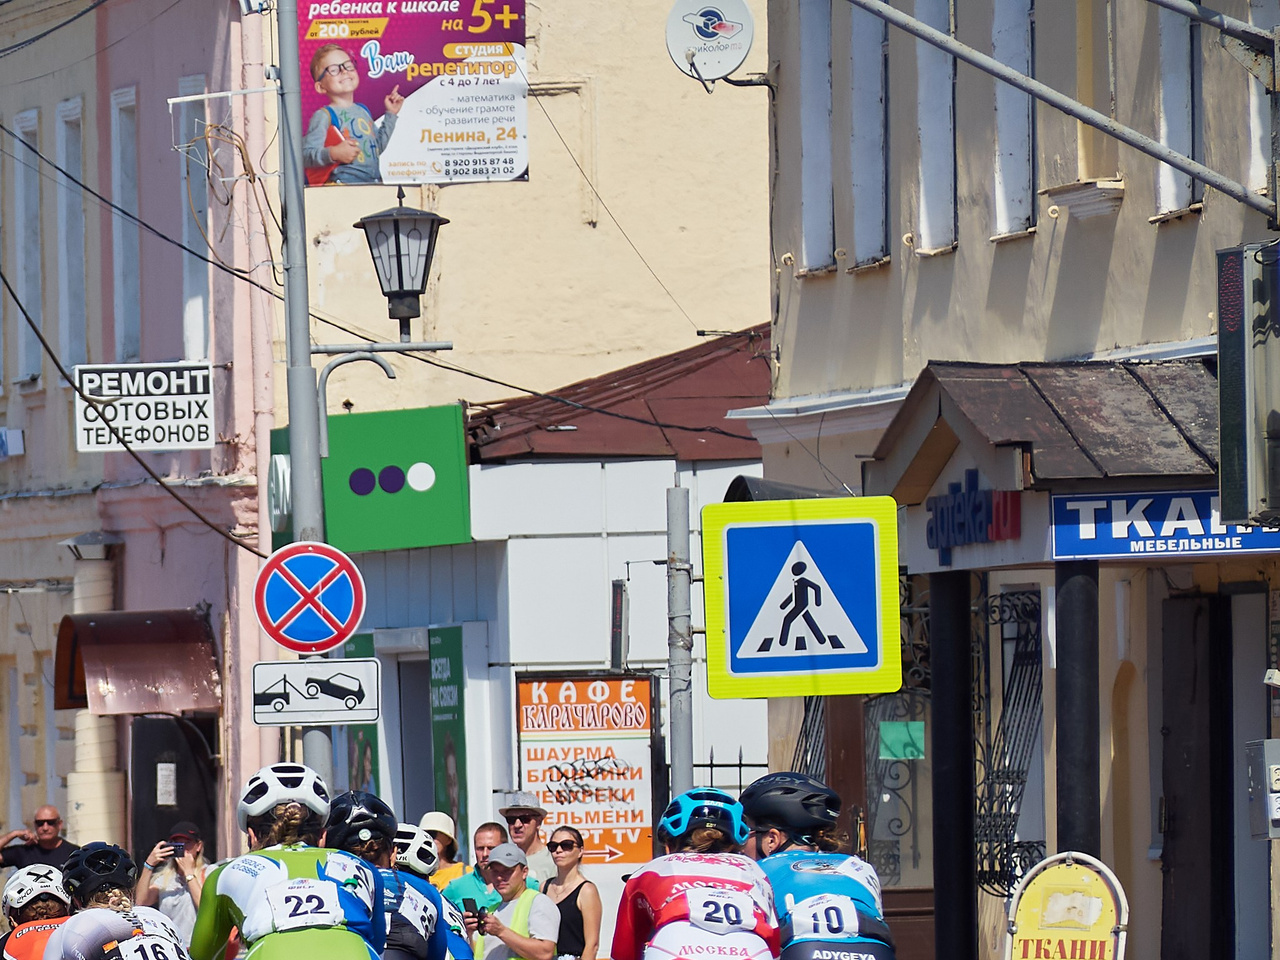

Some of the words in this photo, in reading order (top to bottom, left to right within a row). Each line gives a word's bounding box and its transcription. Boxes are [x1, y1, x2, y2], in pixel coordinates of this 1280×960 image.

[308, 0, 383, 19] ребенка
[386, 1, 398, 14] к
[401, 0, 460, 13] школе
[441, 16, 463, 31] на
[468, 0, 518, 33] 5+
[319, 24, 350, 37] 200
[350, 28, 380, 36] рублей
[361, 40, 414, 78] Ваш
[455, 43, 504, 56] студия
[407, 60, 517, 81] репетитор
[448, 77, 456, 86] 4
[458, 78, 472, 88] до
[474, 77, 480, 86] 7
[482, 77, 501, 86] лет
[457, 94, 516, 103] математика
[426, 106, 474, 116] обучение
[475, 105, 516, 115] грамоте
[445, 117, 490, 127] развитие
[492, 116, 516, 126] речи
[420, 129, 491, 144] Ленина,
[496, 127, 518, 141] 24
[445, 159, 451, 167] 8
[452, 159, 470, 167] 920
[472, 158, 487, 166] 915
[489, 158, 500, 166] 87
[503, 157, 514, 165] 48
[445, 168, 451, 176] 8
[452, 168, 470, 176] 902
[472, 167, 490, 175] 883
[503, 166, 515, 174] 02
[82, 370, 209, 395] РЕМОНТ
[83, 400, 208, 422] СОТОВЫХ
[83, 424, 210, 445] ТЕЛЕФОНОВ
[926, 469, 1021, 566] apteka.ru
[1066, 496, 1280, 541] ТКА
[1130, 537, 1242, 552] МЕБЕЛЬНЫЕ
[532, 680, 637, 704] КАФЕ
[522, 702, 647, 730] КАРАЧАРОВО
[527, 746, 616, 762] ШАУРМА
[543, 810, 644, 825] ЕЛЬМЕНИ
[612, 828, 641, 843] TV
[284, 895, 330, 918] 22
[703, 900, 743, 925] 20
[811, 905, 845, 935] 10
[678, 945, 749, 957] МОСКВА
[1018, 938, 1107, 960] ТКАНИ
